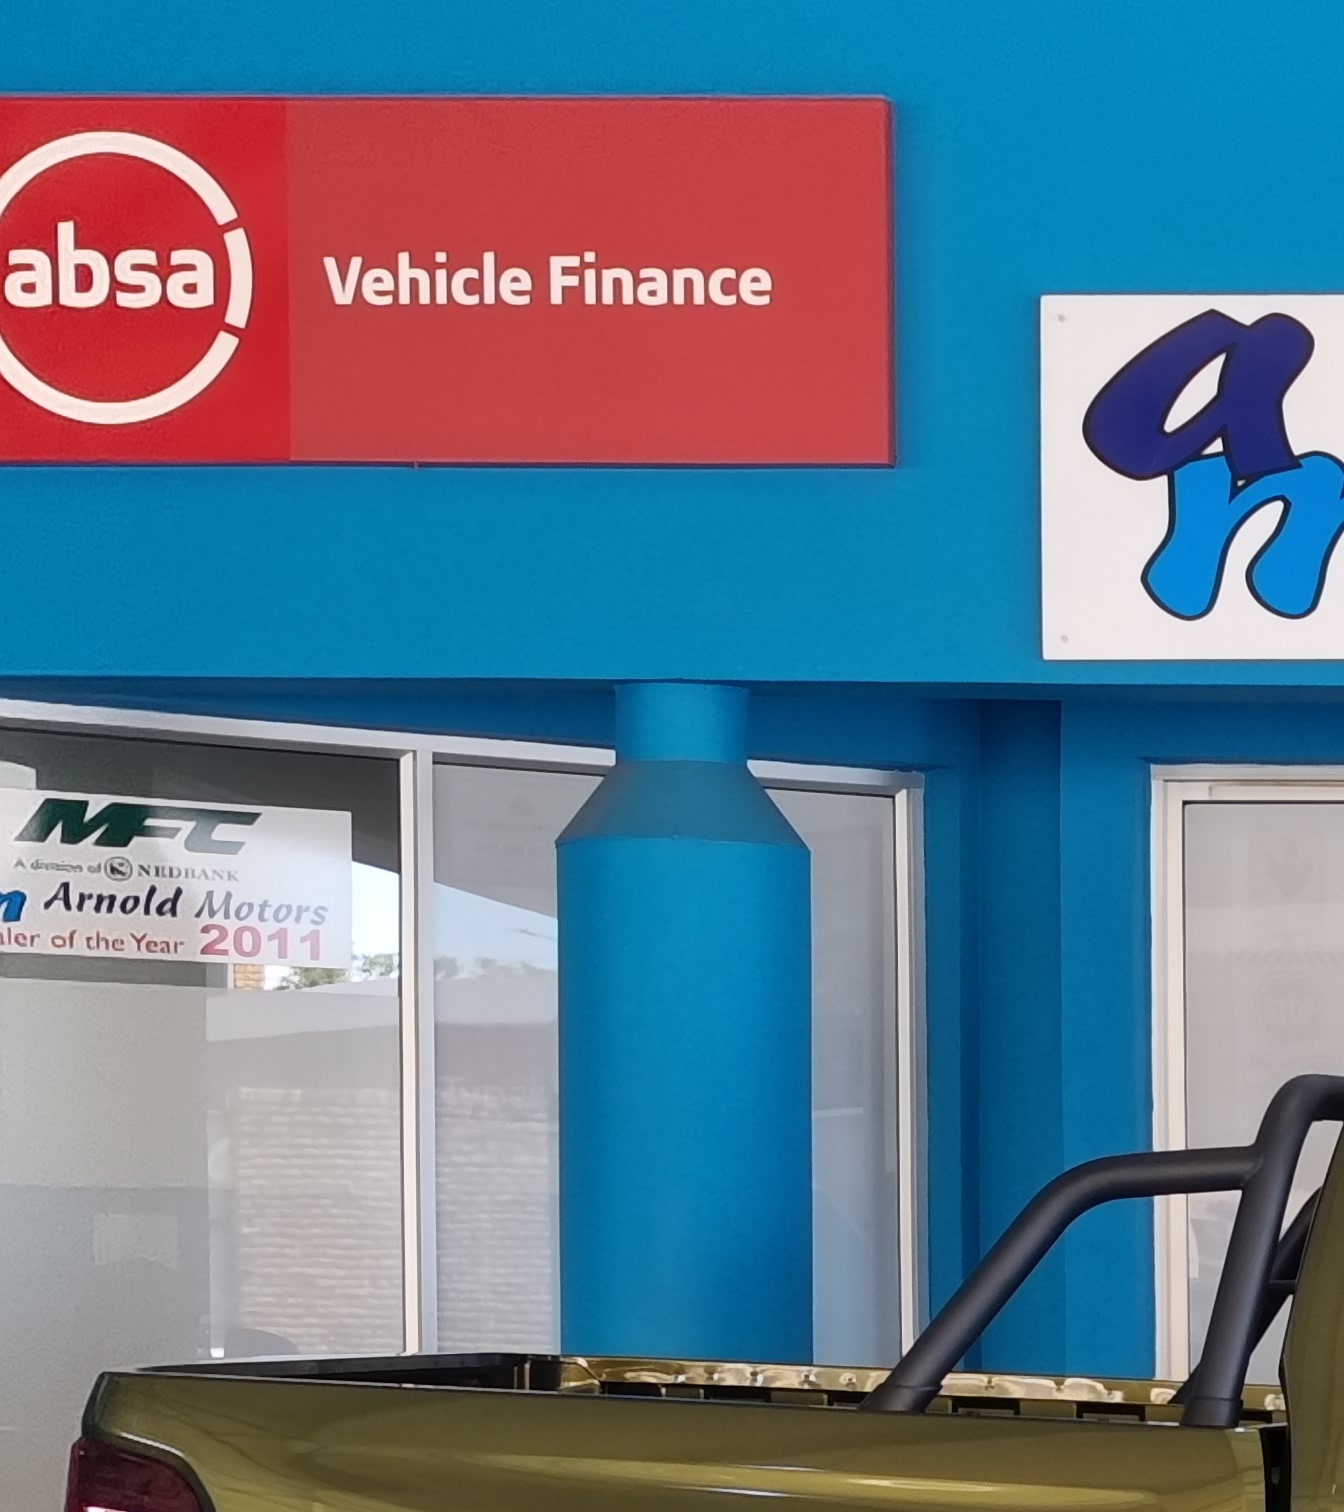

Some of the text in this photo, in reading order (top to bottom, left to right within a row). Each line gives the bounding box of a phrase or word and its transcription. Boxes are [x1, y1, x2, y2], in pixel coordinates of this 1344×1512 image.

[4, 220, 215, 309] absa
[322, 250, 772, 307] Vehicle Finance
[14, 798, 262, 855] MFC
[44, 881, 183, 918] Arnold
[194, 889, 328, 926] Motors
[51, 929, 77, 949] of
[86, 930, 125, 951] the
[130, 932, 184, 954] Year
[200, 923, 321, 961] 2011
